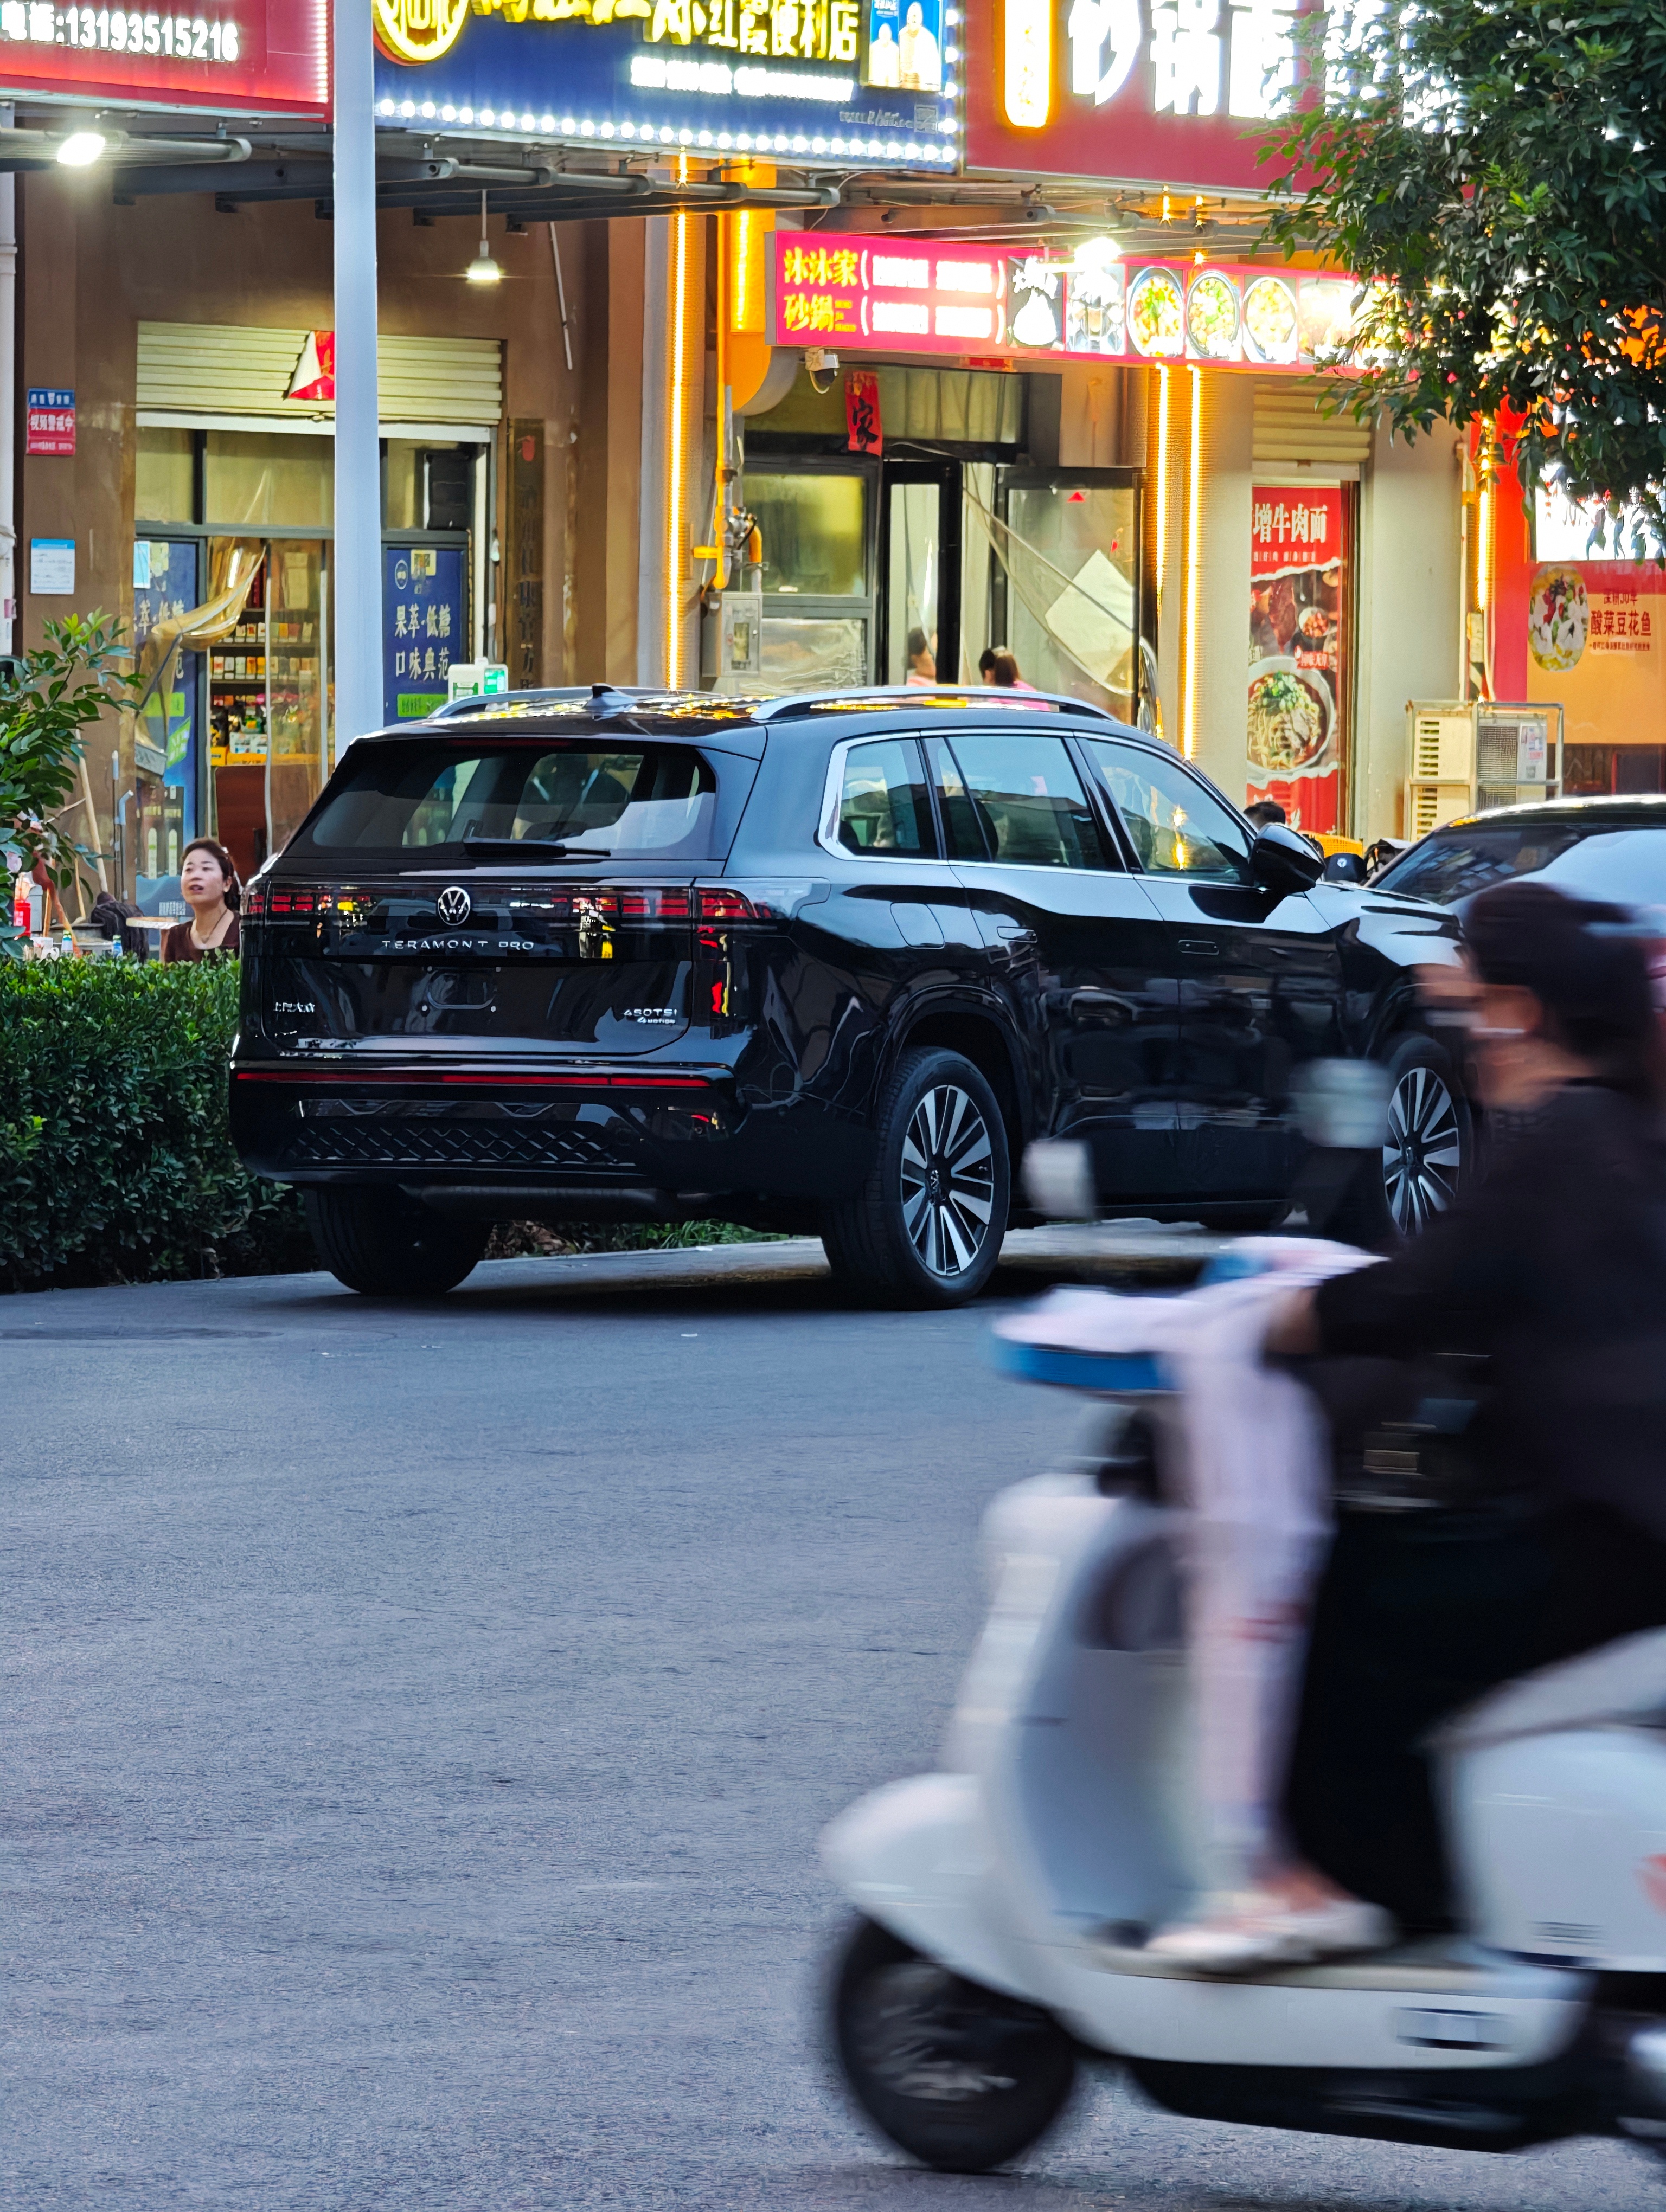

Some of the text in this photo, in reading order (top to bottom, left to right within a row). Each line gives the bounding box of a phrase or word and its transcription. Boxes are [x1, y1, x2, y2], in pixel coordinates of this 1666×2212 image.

[1591, 609, 1651, 636] 酸菜豆花鱼
[382, 940, 534, 950] TERAMONT PRO
[623, 1008, 677, 1017] 450TSI
